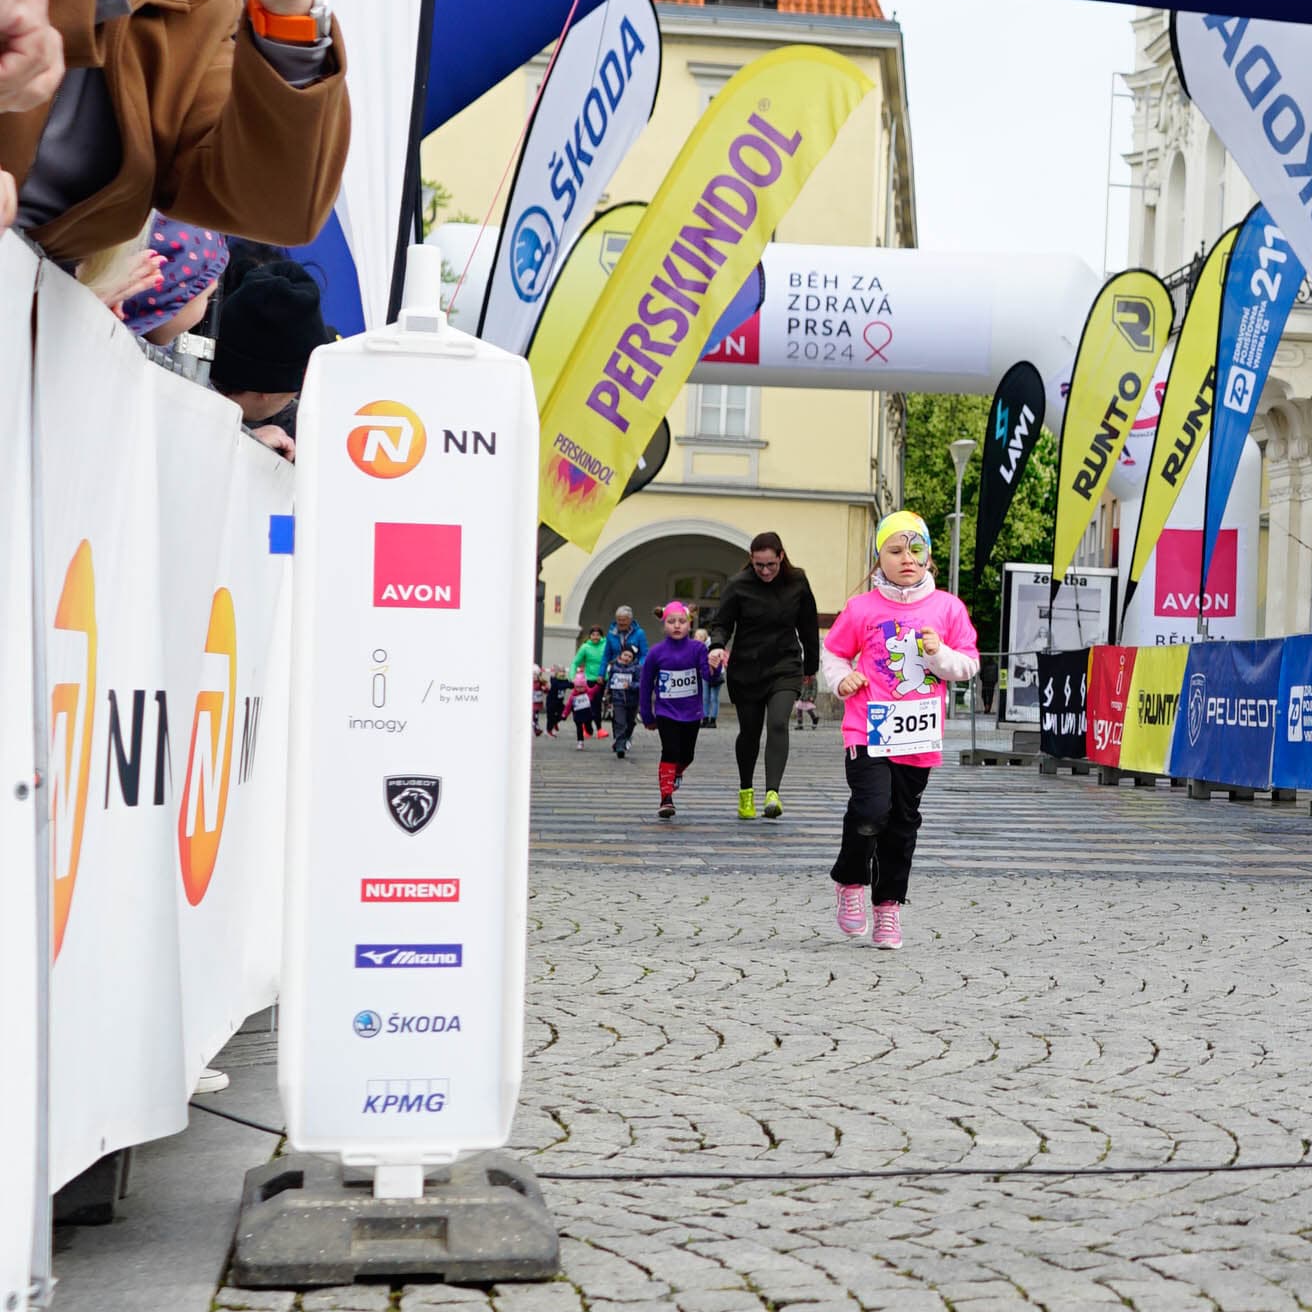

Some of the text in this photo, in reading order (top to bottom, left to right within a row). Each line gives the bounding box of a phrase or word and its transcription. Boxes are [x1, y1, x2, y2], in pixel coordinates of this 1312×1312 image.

[548, 15, 646, 223] ŠKODA
[585, 111, 803, 434] PERSKINDOL
[789, 270, 883, 292] BĚH ZA
[787, 293, 893, 316] ZDRAVÁ
[787, 317, 852, 337] PRSA
[786, 340, 855, 361] 2024
[1071, 371, 1142, 501] RUNTO
[1161, 365, 1216, 488] RUNT
[442, 429, 497, 456] NN
[999, 403, 1036, 485] LAWI
[553, 432, 616, 486] PERSKINDOL
[1033, 572, 1088, 586] žetba
[381, 584, 452, 602] AVON
[1162, 592, 1230, 611] AVON
[440, 683, 480, 693] Powered
[671, 675, 697, 688] 3002
[440, 694, 451, 703] by
[893, 713, 937, 733] 3051
[1206, 697, 1278, 729] PEUGEOT
[348, 715, 408, 733] innogy
[388, 779, 438, 787] PEUGEOT
[365, 883, 457, 898] NUTREND
[386, 1012, 462, 1034] ŠKODA
[362, 1092, 446, 1114] KPMG
